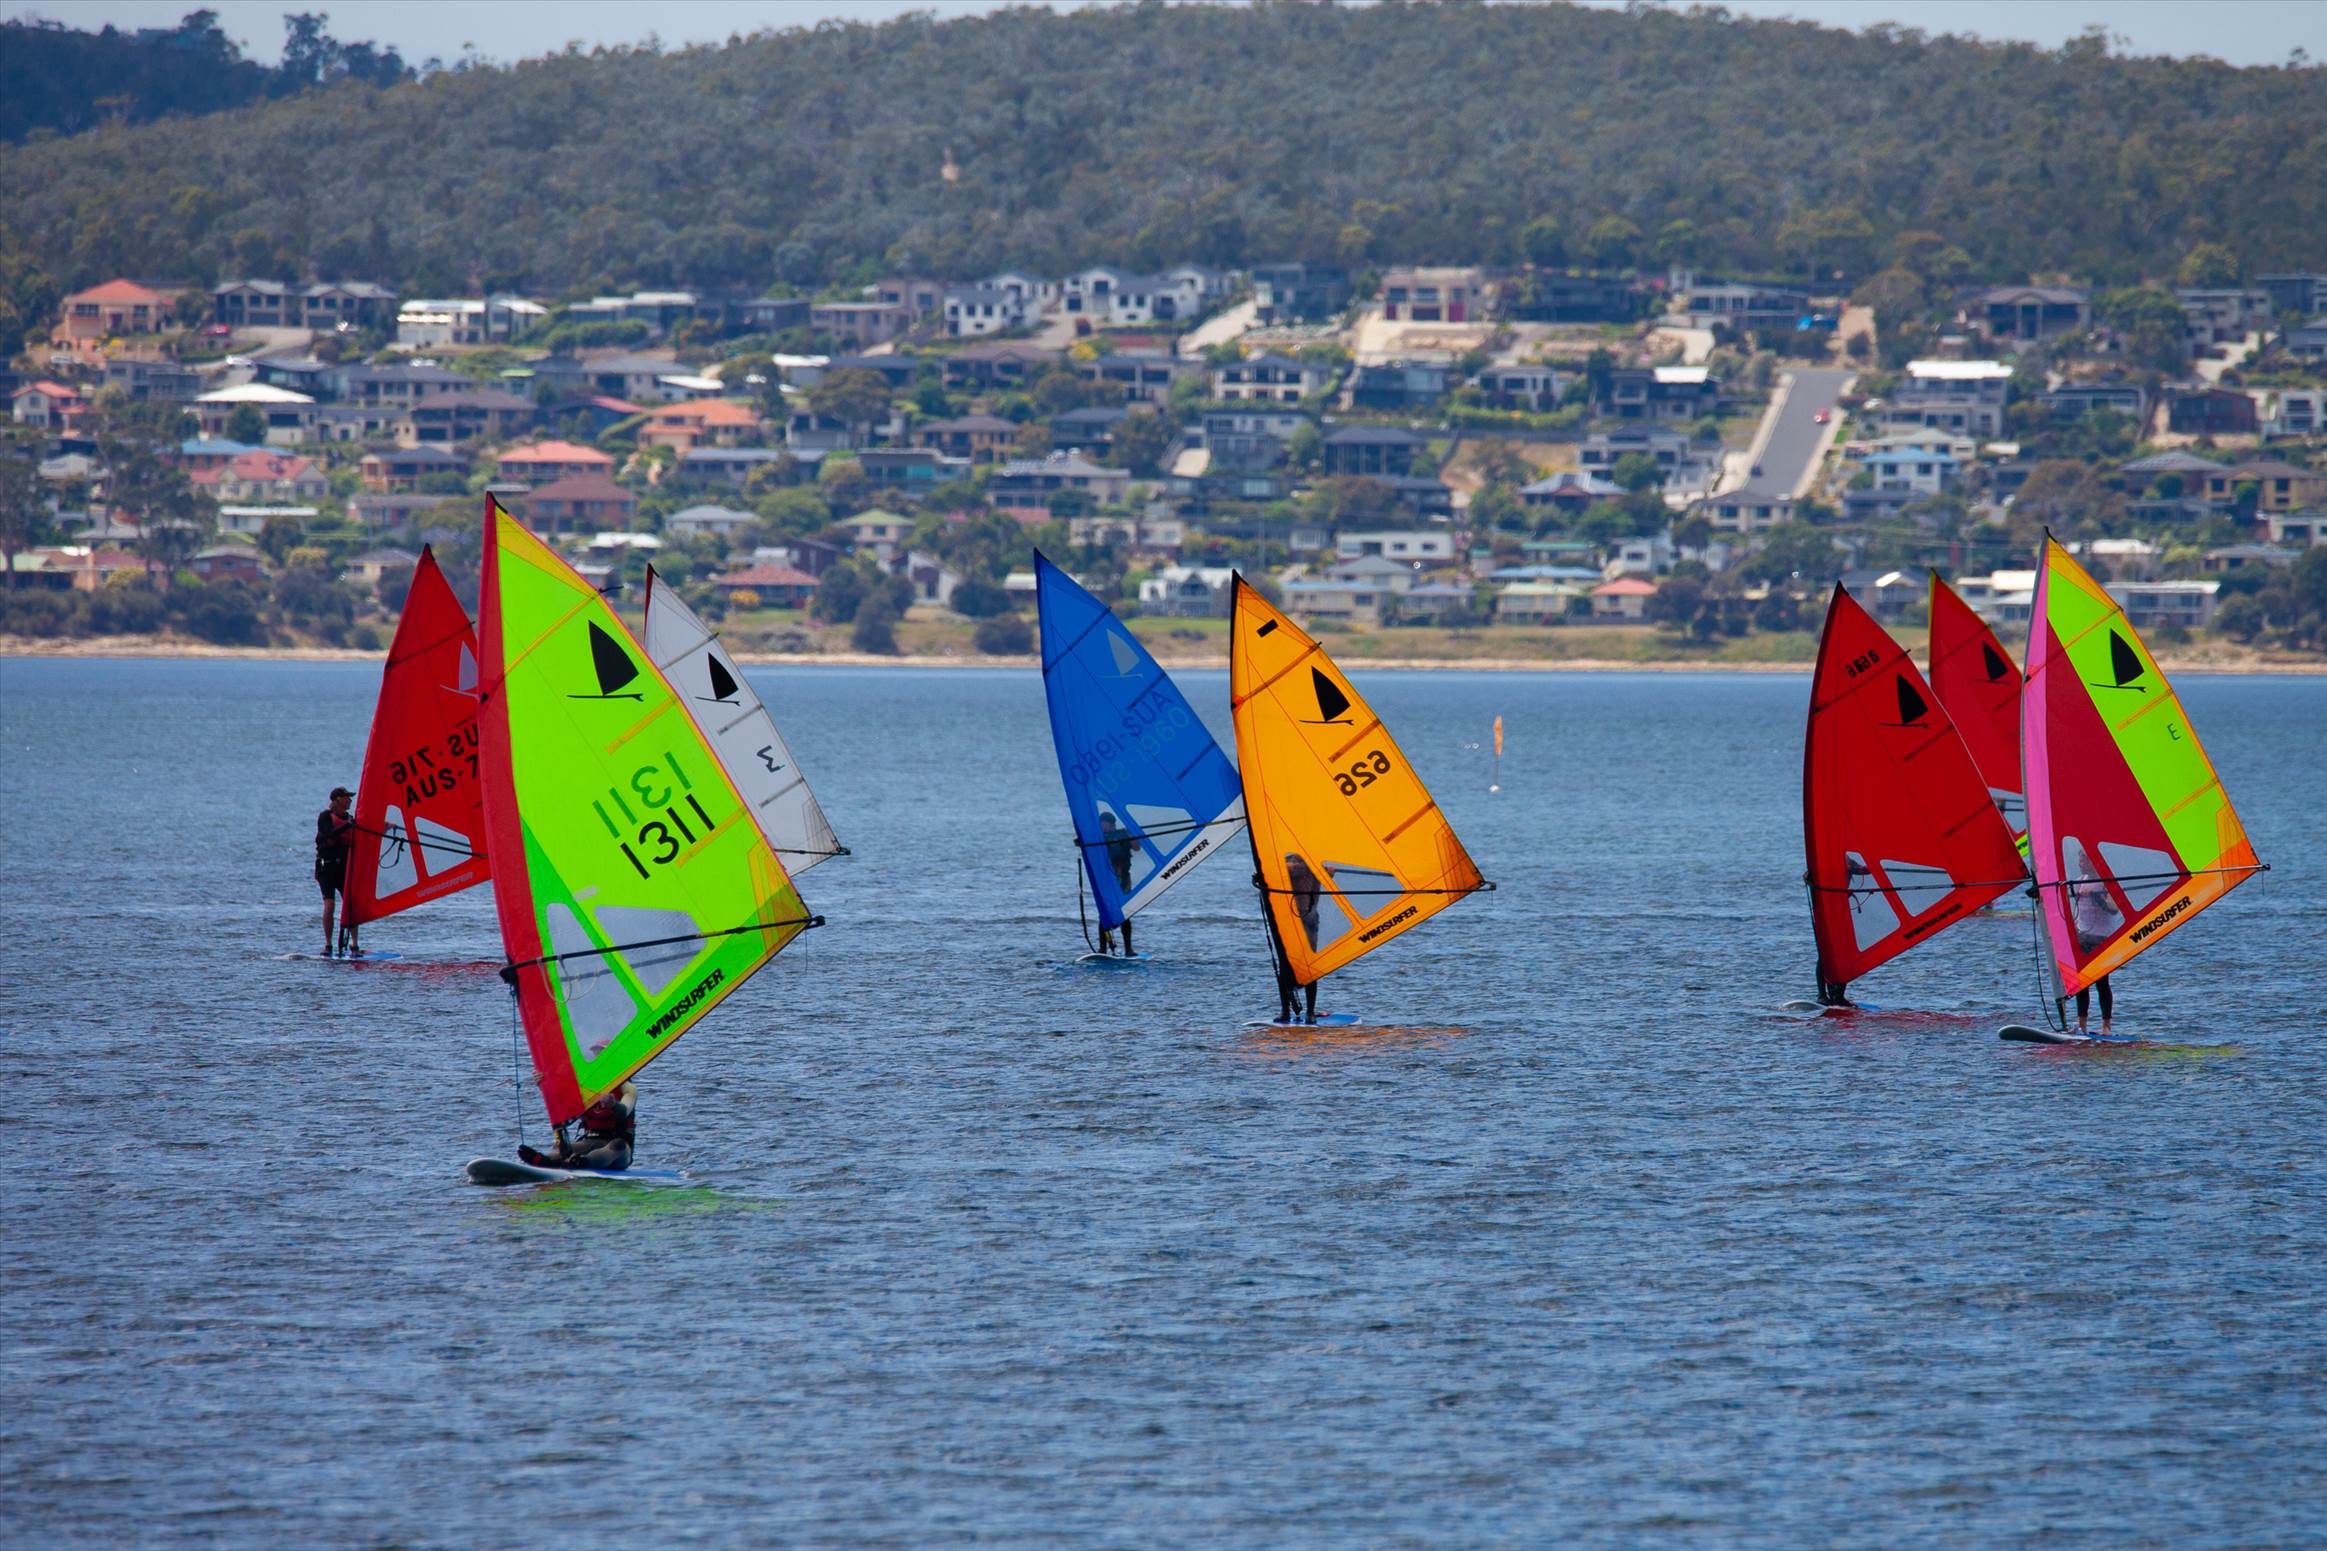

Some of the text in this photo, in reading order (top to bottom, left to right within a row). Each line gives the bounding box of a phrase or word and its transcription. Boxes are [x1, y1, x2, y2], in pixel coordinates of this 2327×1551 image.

[620, 793, 716, 880] 1311
[1160, 838, 1210, 880] WINDSURFER
[1358, 905, 1418, 943] WINDSURFER
[2129, 895, 2192, 943] WINDSURFER
[646, 968, 724, 1039] WINDSURFER
